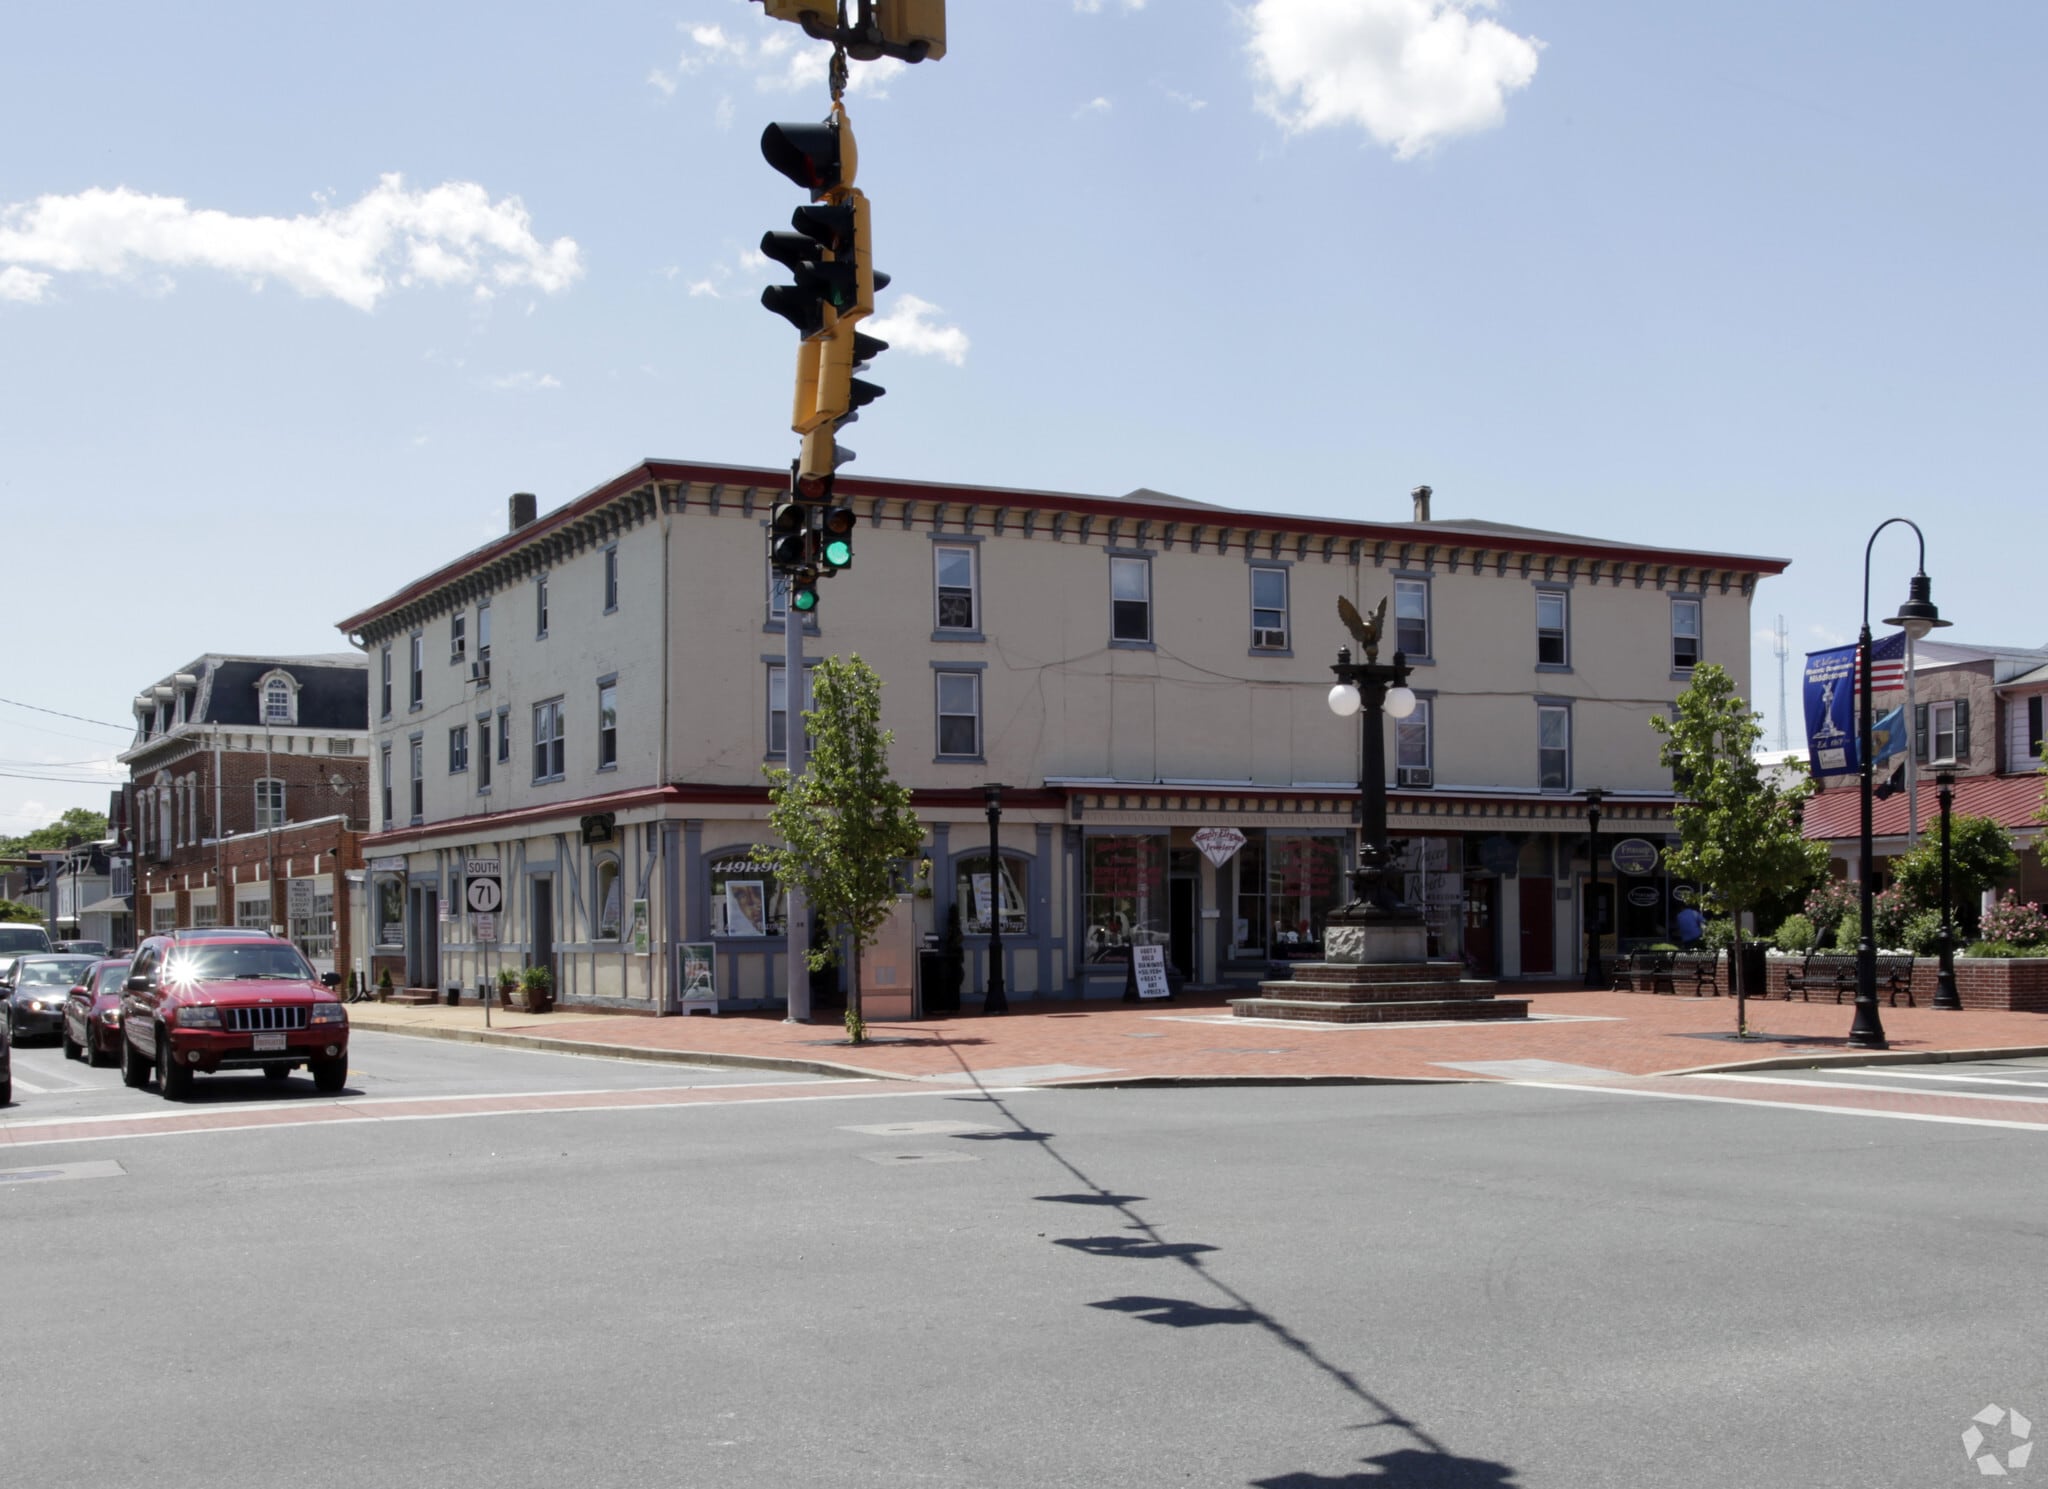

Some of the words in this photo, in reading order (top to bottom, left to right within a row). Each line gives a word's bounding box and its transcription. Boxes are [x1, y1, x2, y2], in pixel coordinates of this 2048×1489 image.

[1809, 671, 1848, 683] Middletown
[469, 862, 499, 873] SOUTH
[475, 885, 491, 904] 71
